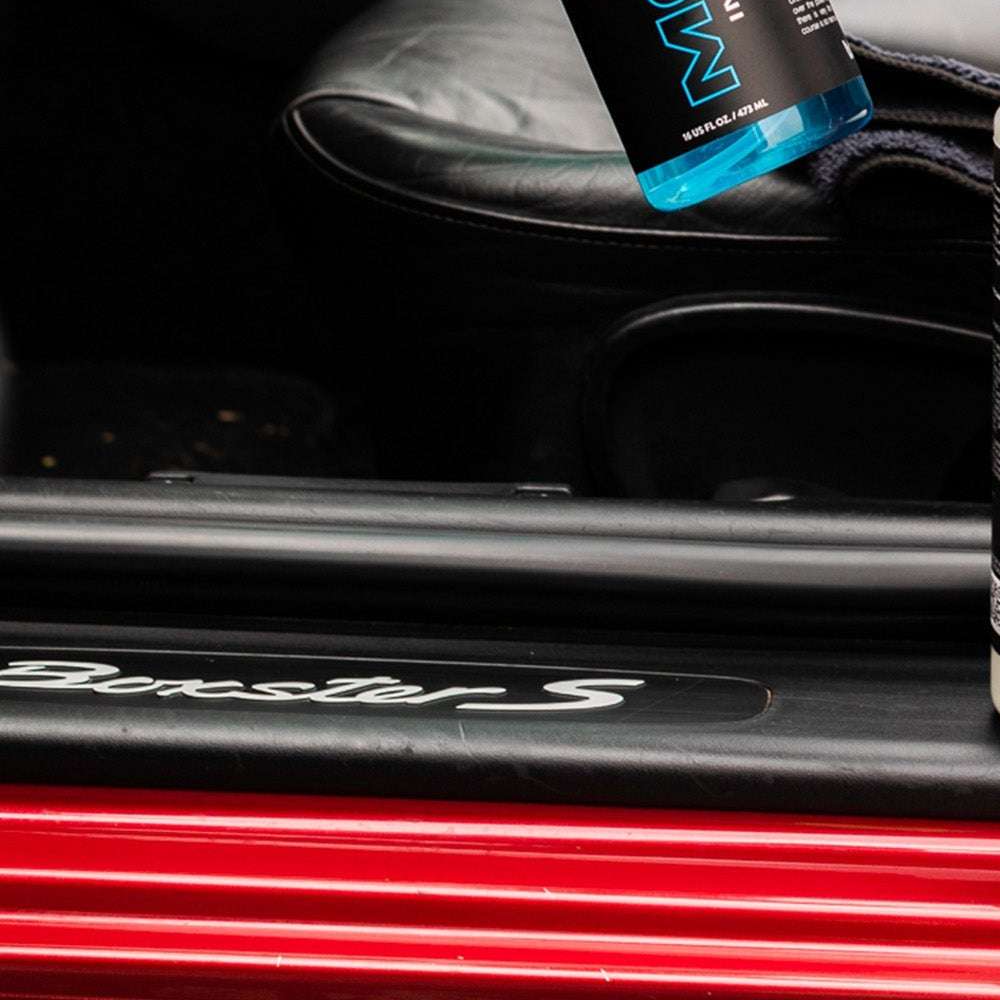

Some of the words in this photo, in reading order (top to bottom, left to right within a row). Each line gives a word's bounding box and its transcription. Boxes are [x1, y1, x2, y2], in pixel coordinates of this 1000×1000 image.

[682, 131, 693, 142] 16
[691, 125, 705, 138] US
[704, 121, 717, 132] FL
[737, 104, 754, 117] 473
[753, 98, 769, 110] ML
[0, 660, 507, 705] Boxster
[455, 678, 646, 710] S
